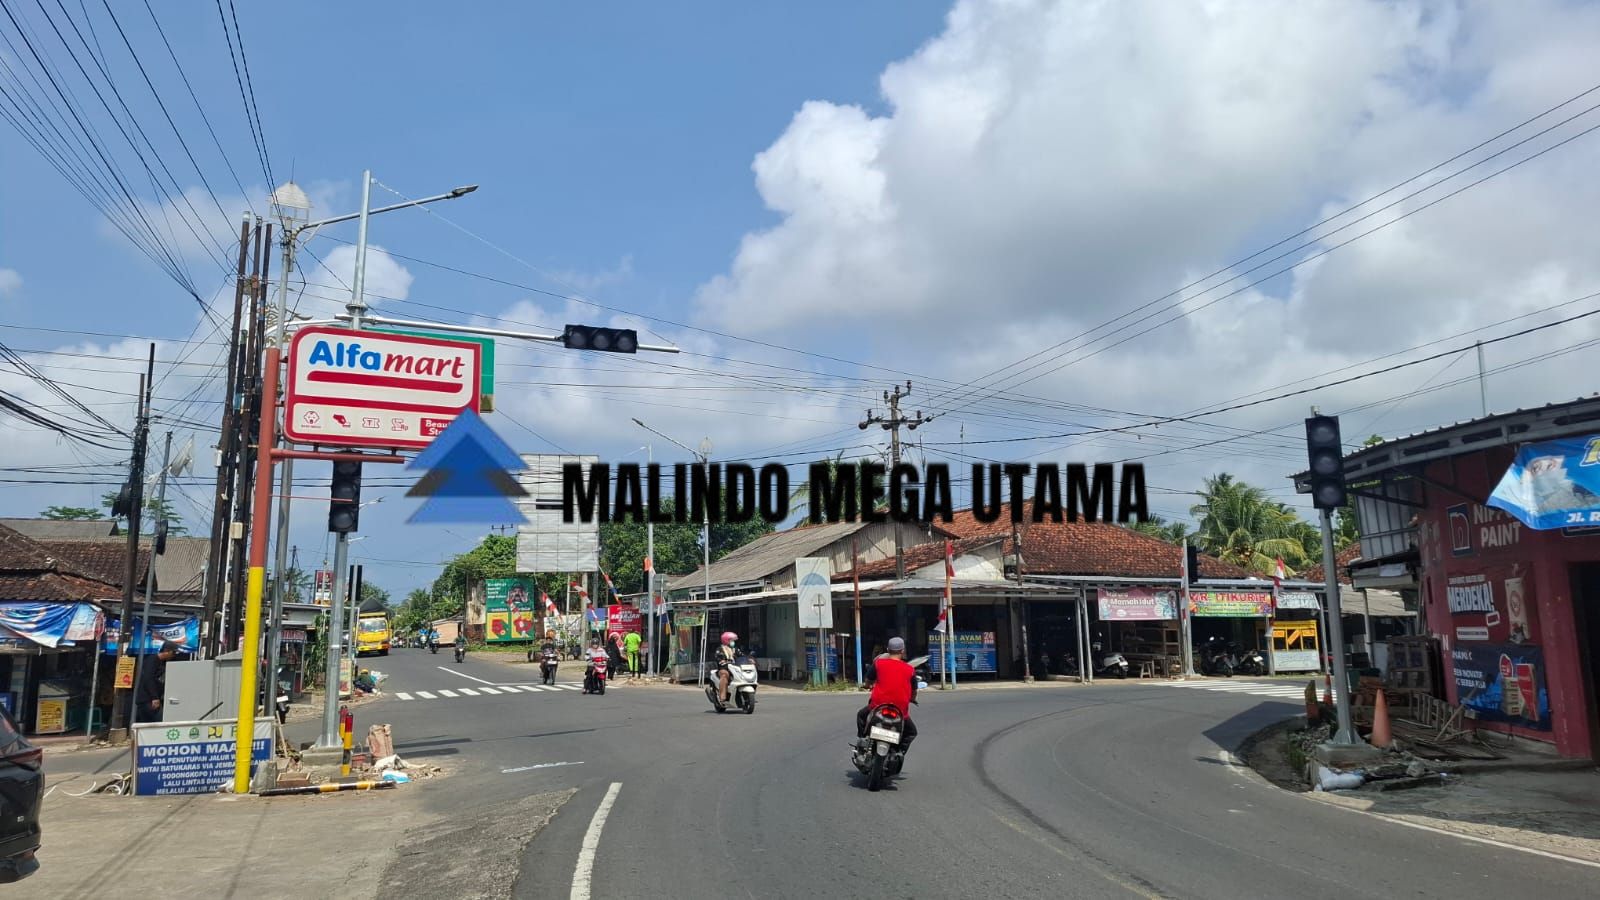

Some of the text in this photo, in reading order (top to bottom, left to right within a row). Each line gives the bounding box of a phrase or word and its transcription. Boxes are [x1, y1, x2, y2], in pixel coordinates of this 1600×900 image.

[308, 340, 464, 379] Alfamart
[425, 419, 449, 428] Beau
[1481, 521, 1521, 548] PAINT
[1447, 581, 1495, 613] MERDEKA!
[143, 745, 201, 757] MOHON
[206, 743, 236, 754] MAA
[167, 755, 207, 764] PENUTUPAN
[160, 763, 201, 772] BATUKARAS
